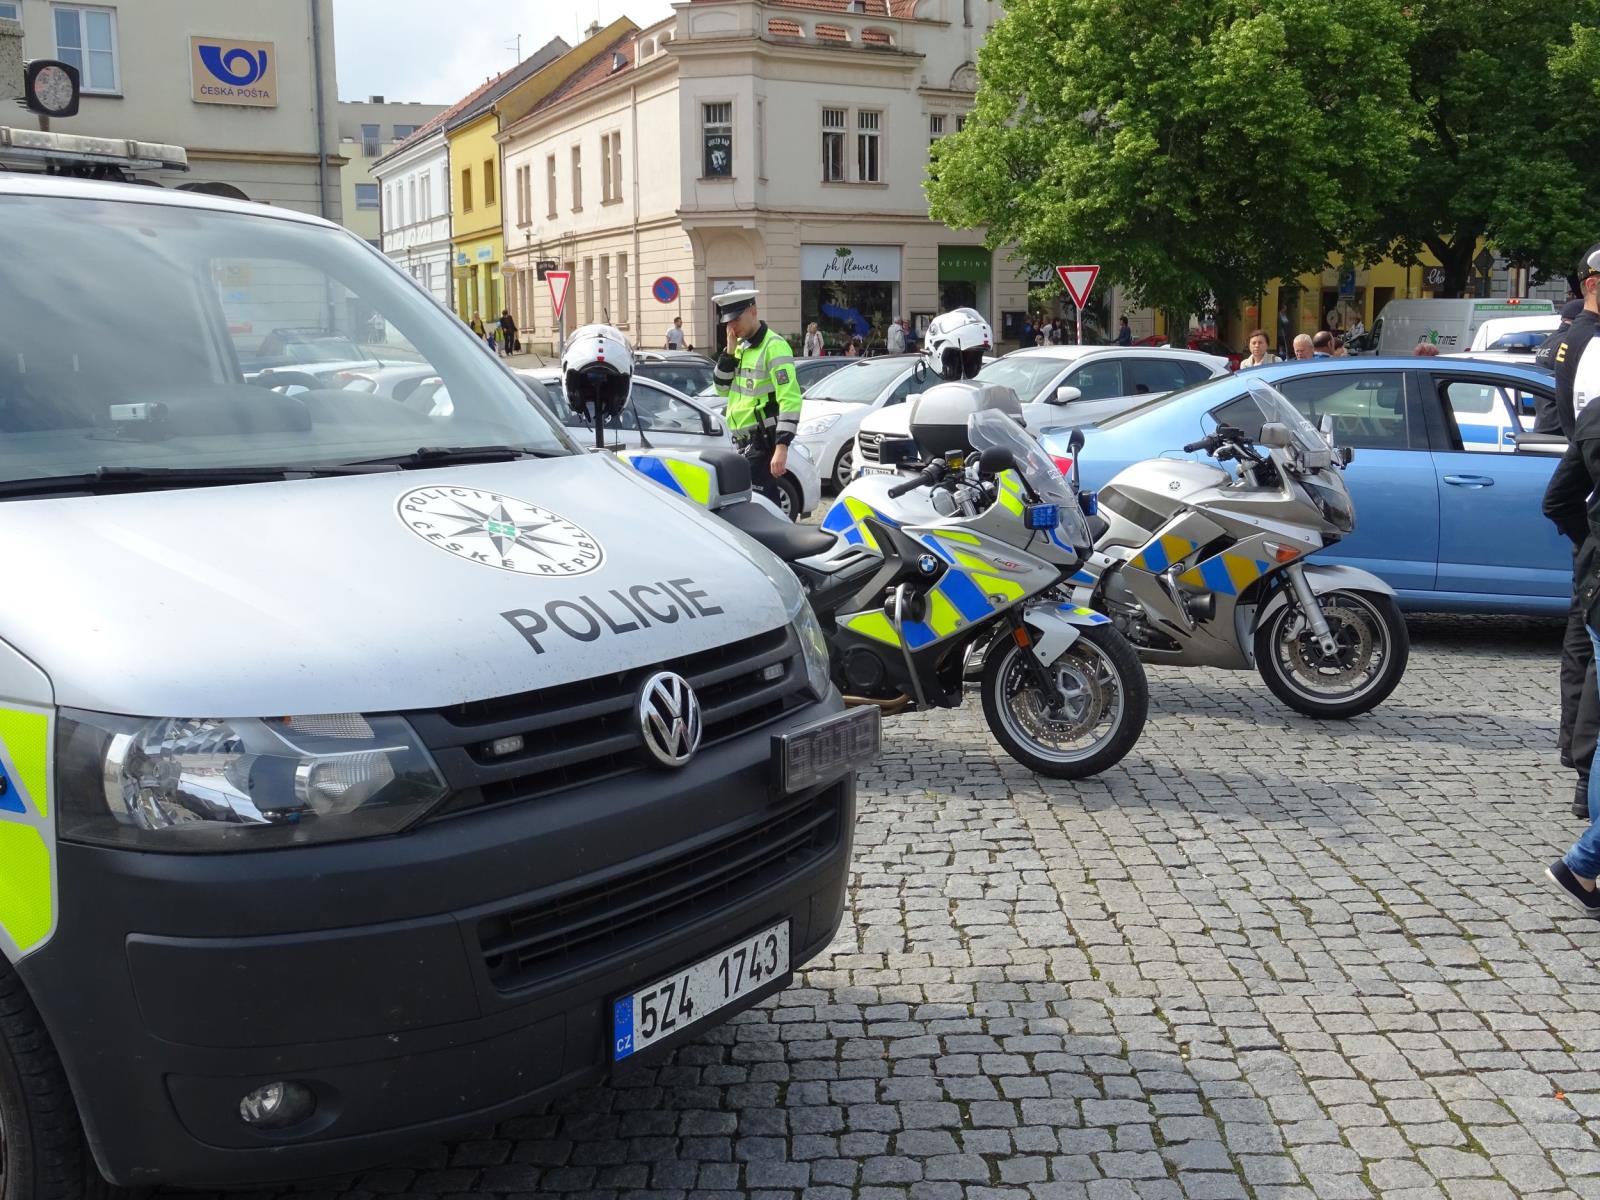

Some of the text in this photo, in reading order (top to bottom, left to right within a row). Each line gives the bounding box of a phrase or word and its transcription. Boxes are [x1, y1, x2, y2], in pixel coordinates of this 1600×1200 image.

[200, 84, 270, 98] ČESKÁ POŠTA
[823, 257, 880, 278] ph flowers
[1437, 335, 1457, 345] TIME
[404, 488, 597, 574] POLICIE ČESKÉ REPUBLIKY
[499, 577, 725, 655] POLICIE
[640, 934, 778, 1039] 5Z4 1743
[616, 1034, 632, 1052] CZ
